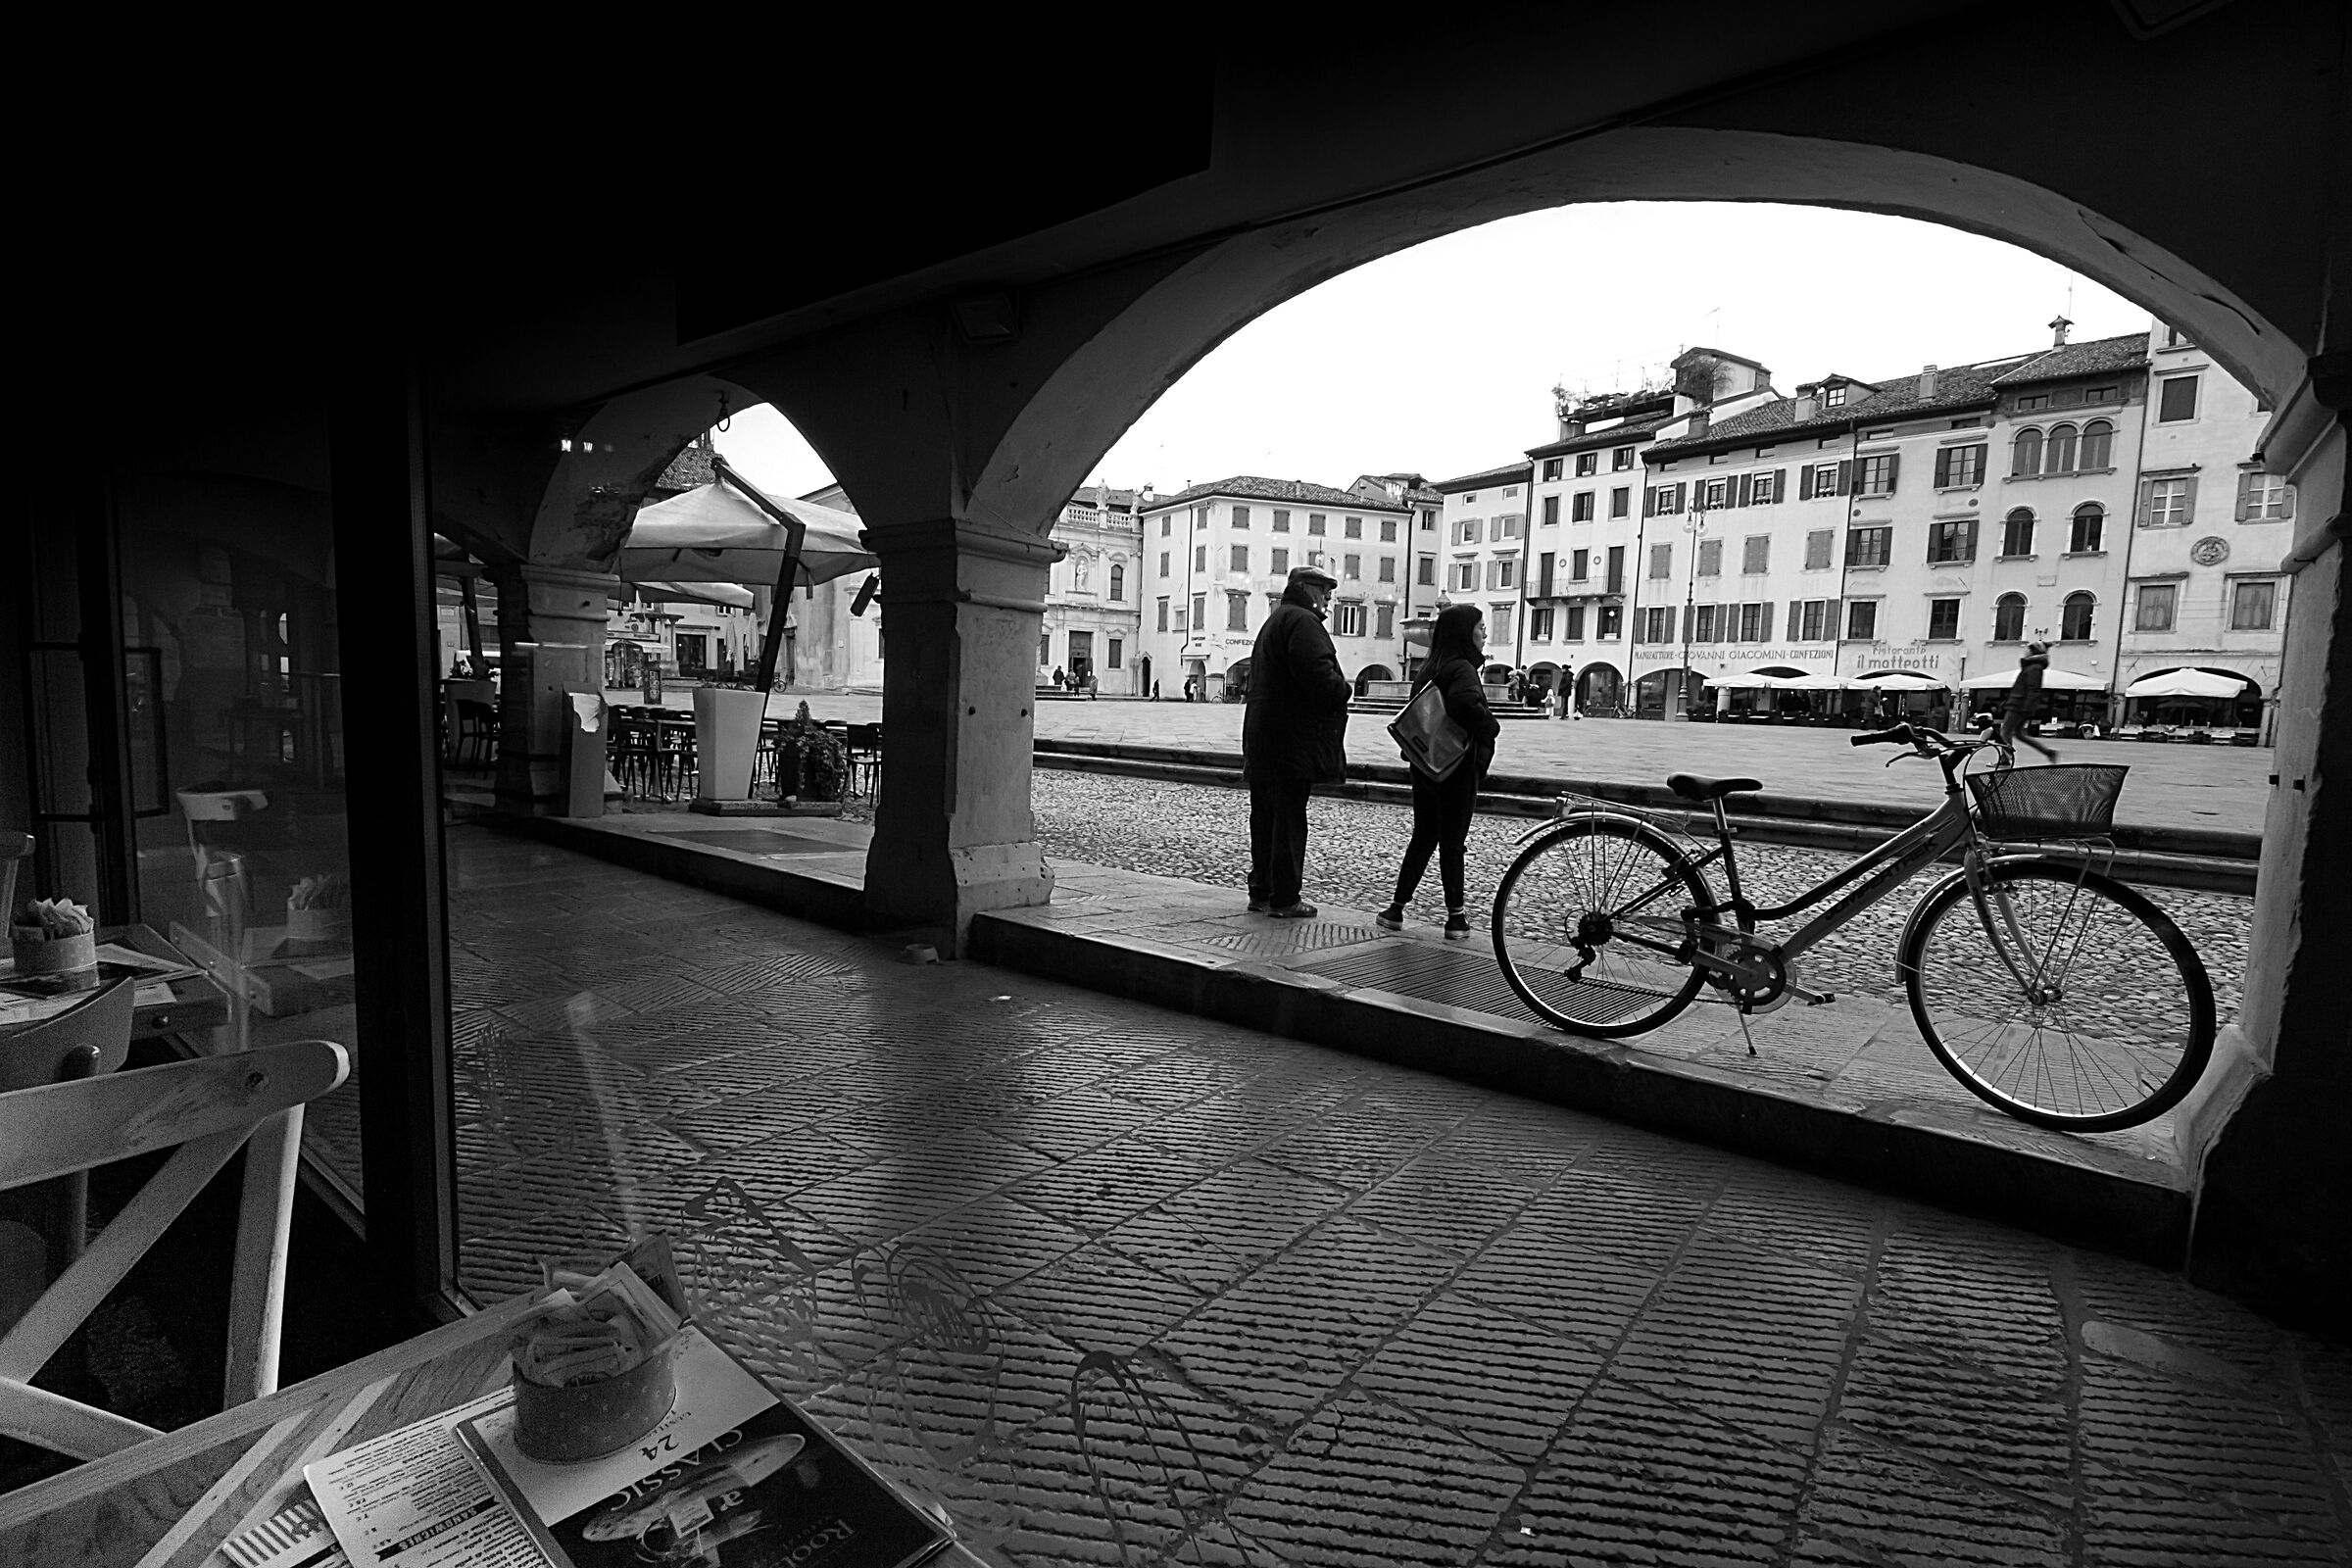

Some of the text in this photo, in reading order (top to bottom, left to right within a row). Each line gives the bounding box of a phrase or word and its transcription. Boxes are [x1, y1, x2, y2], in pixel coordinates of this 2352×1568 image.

[1678, 650, 1725, 660] GOVANNI
[1729, 650, 1786, 660] GIACOMINI
[1873, 645, 1927, 655] ristorante
[1857, 654, 1939, 668] il matteotti
[640, 1434, 679, 1462] 24
[610, 1428, 744, 1511] CLASSIC
[399, 1506, 477, 1550] SANDWICHES
